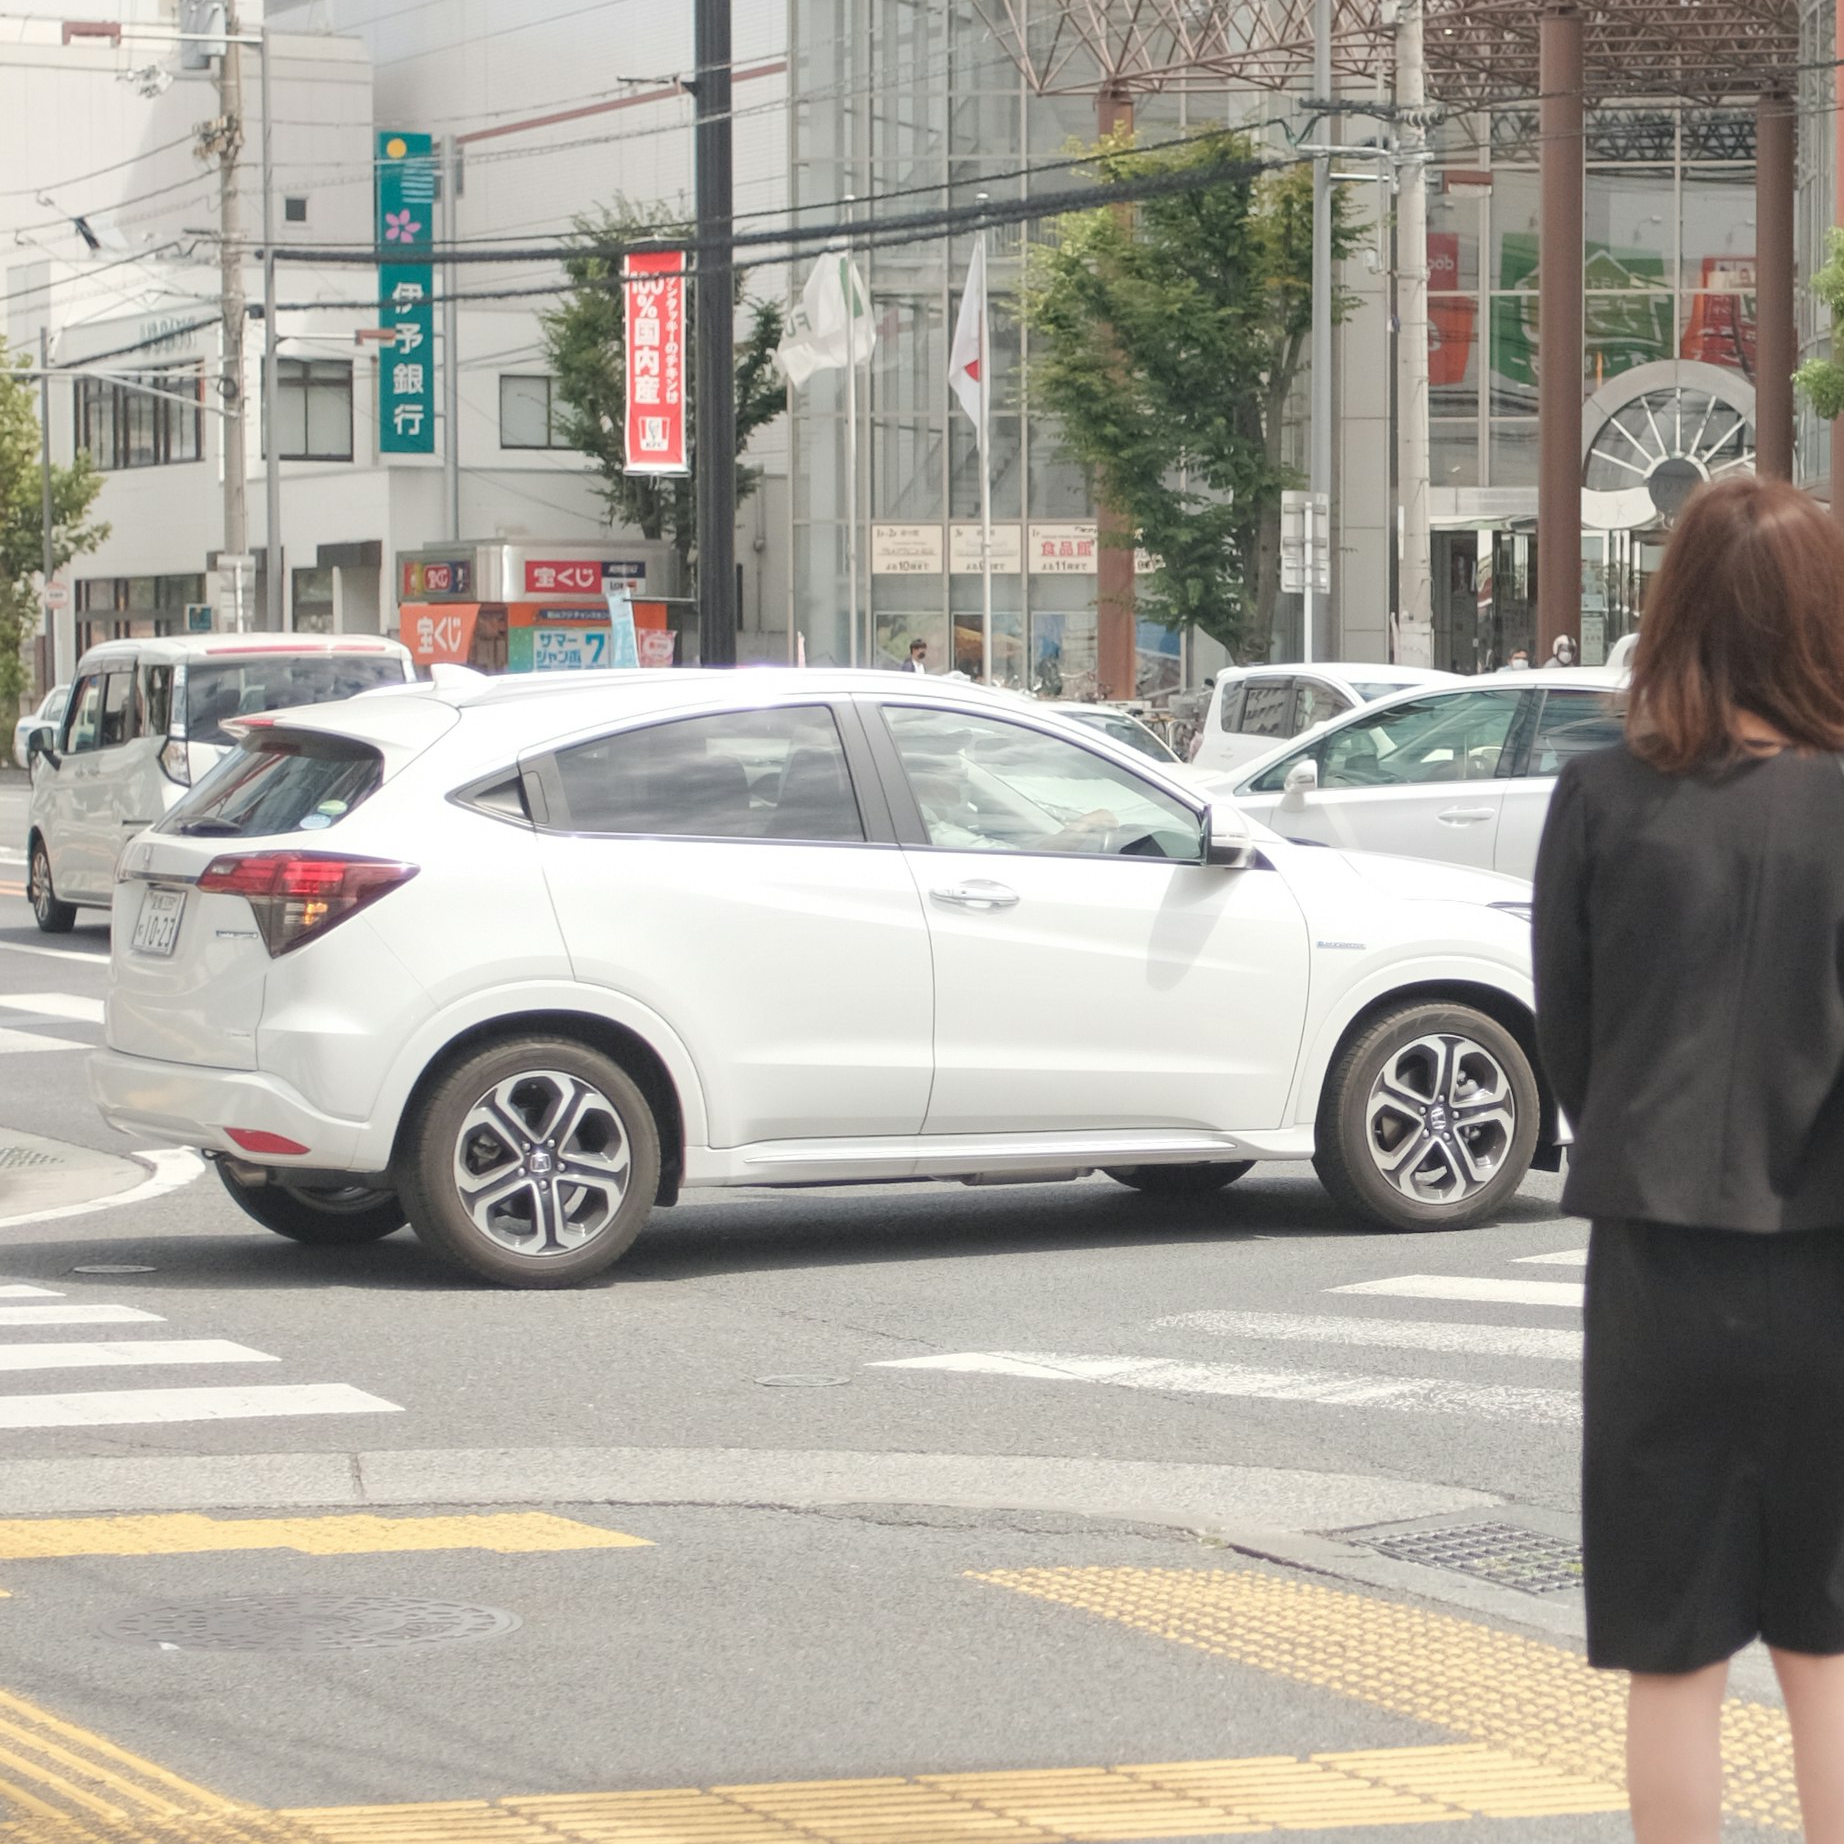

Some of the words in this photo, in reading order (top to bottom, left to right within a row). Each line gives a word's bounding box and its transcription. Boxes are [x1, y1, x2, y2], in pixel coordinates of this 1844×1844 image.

[391, 282, 425, 436] 伊予銀行
[533, 567, 595, 588] 宝くじ
[416, 616, 462, 654] 宝くじ
[540, 633, 578, 647] サマー
